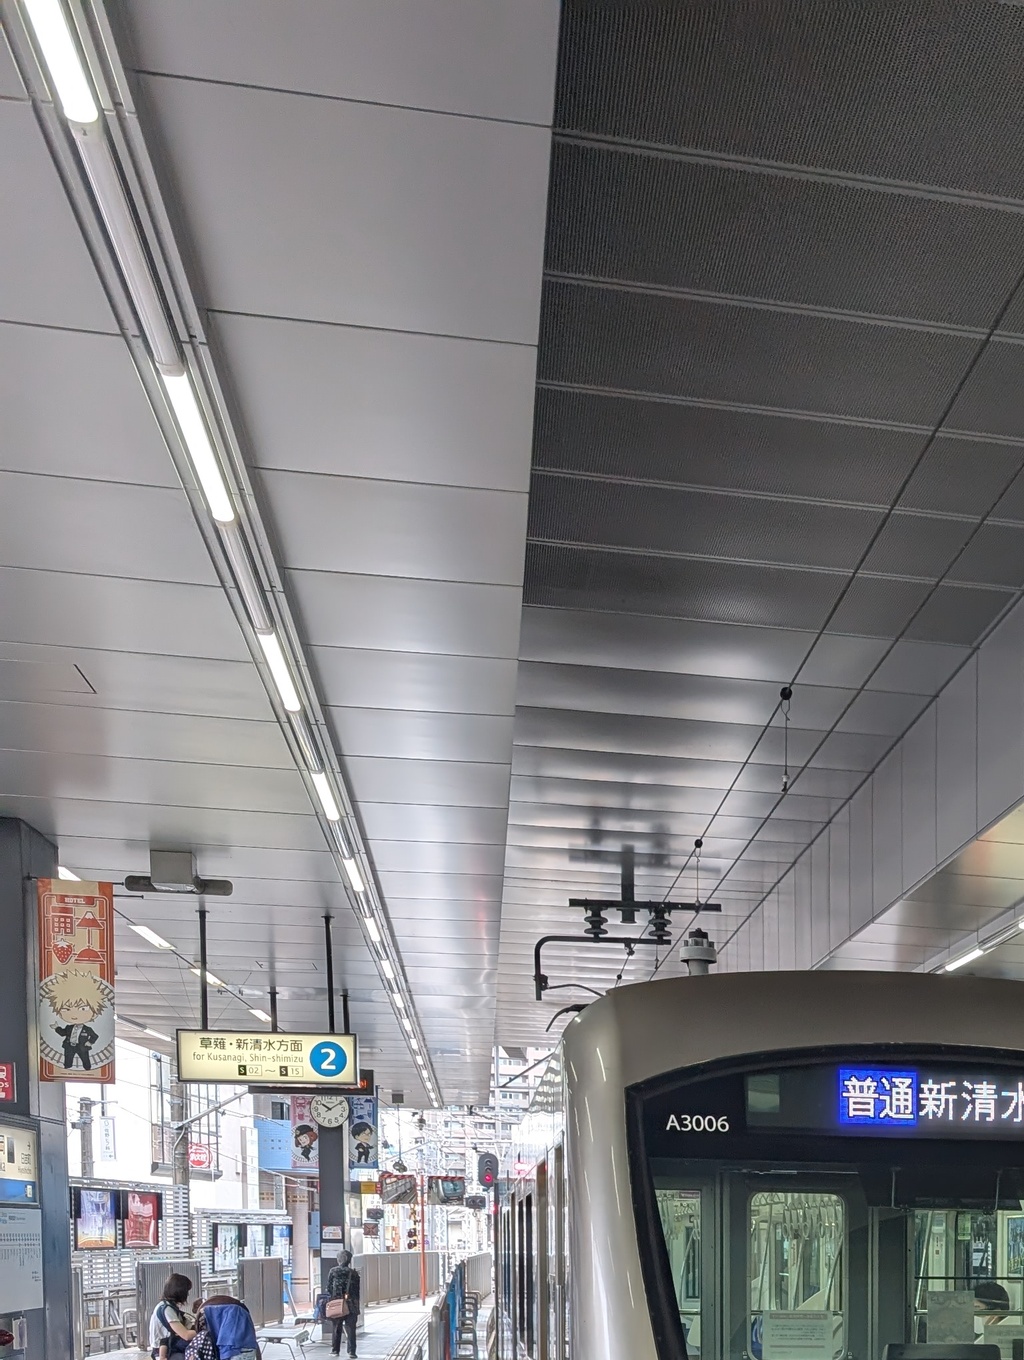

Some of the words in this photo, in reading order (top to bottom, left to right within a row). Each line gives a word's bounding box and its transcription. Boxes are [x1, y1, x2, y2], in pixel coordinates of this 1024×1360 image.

[199, 1037, 303, 1052] 草薙・新清水方面
[192, 1052, 204, 1061] for
[207, 1053, 247, 1063] Kusanagi,
[249, 1053, 304, 1063] Shin-shimizu
[320, 1048, 336, 1070] 2
[841, 1076, 914, 1119] 普通
[665, 1114, 730, 1132] A3006
